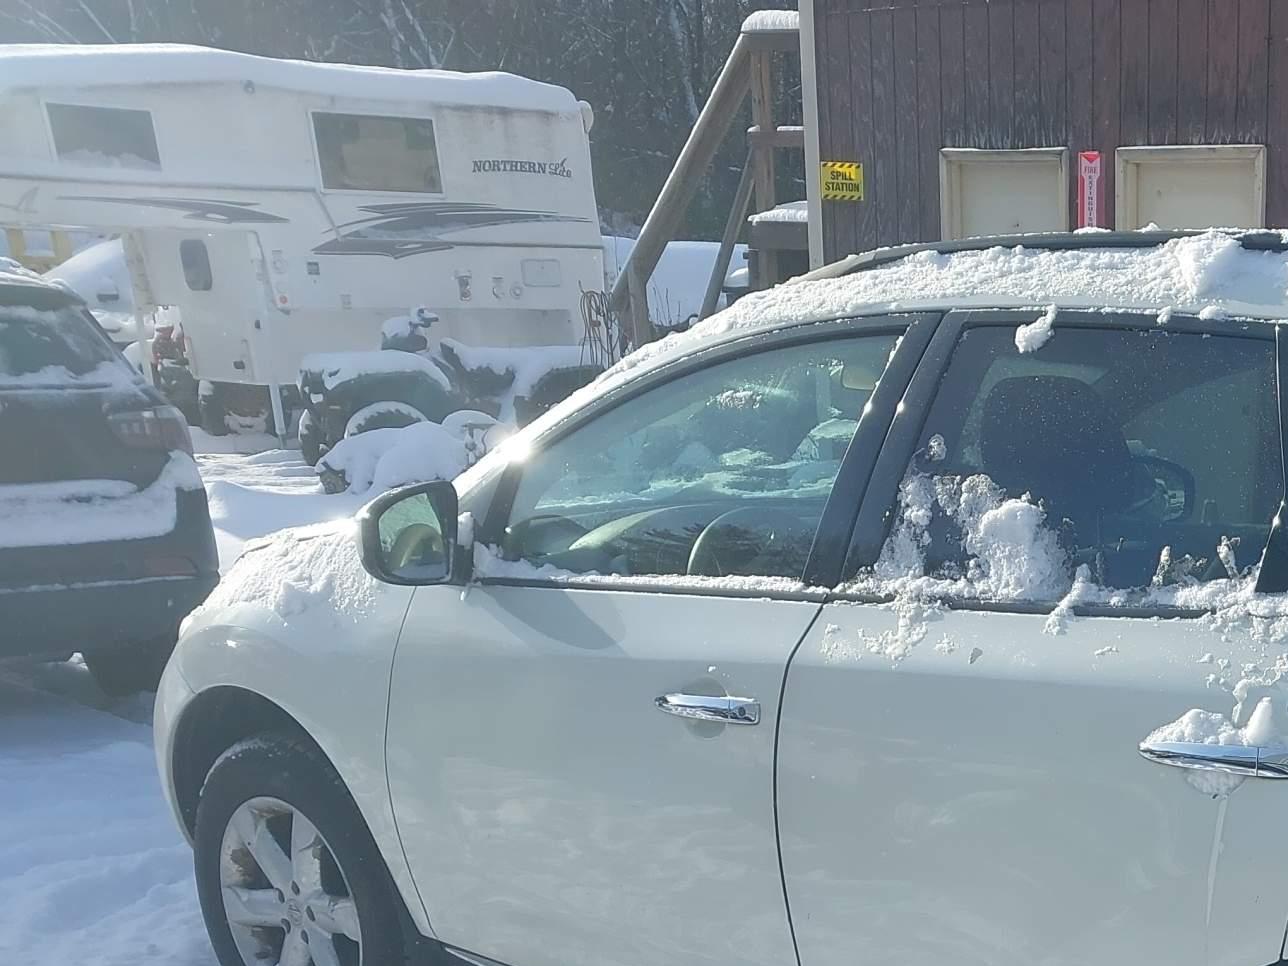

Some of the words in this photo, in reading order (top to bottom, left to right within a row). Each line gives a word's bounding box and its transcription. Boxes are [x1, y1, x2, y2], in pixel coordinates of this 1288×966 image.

[472, 159, 547, 174] NORTHERN
[1084, 166, 1096, 174] FIRE
[830, 170, 855, 181] SPILL
[824, 181, 860, 193] STATION
